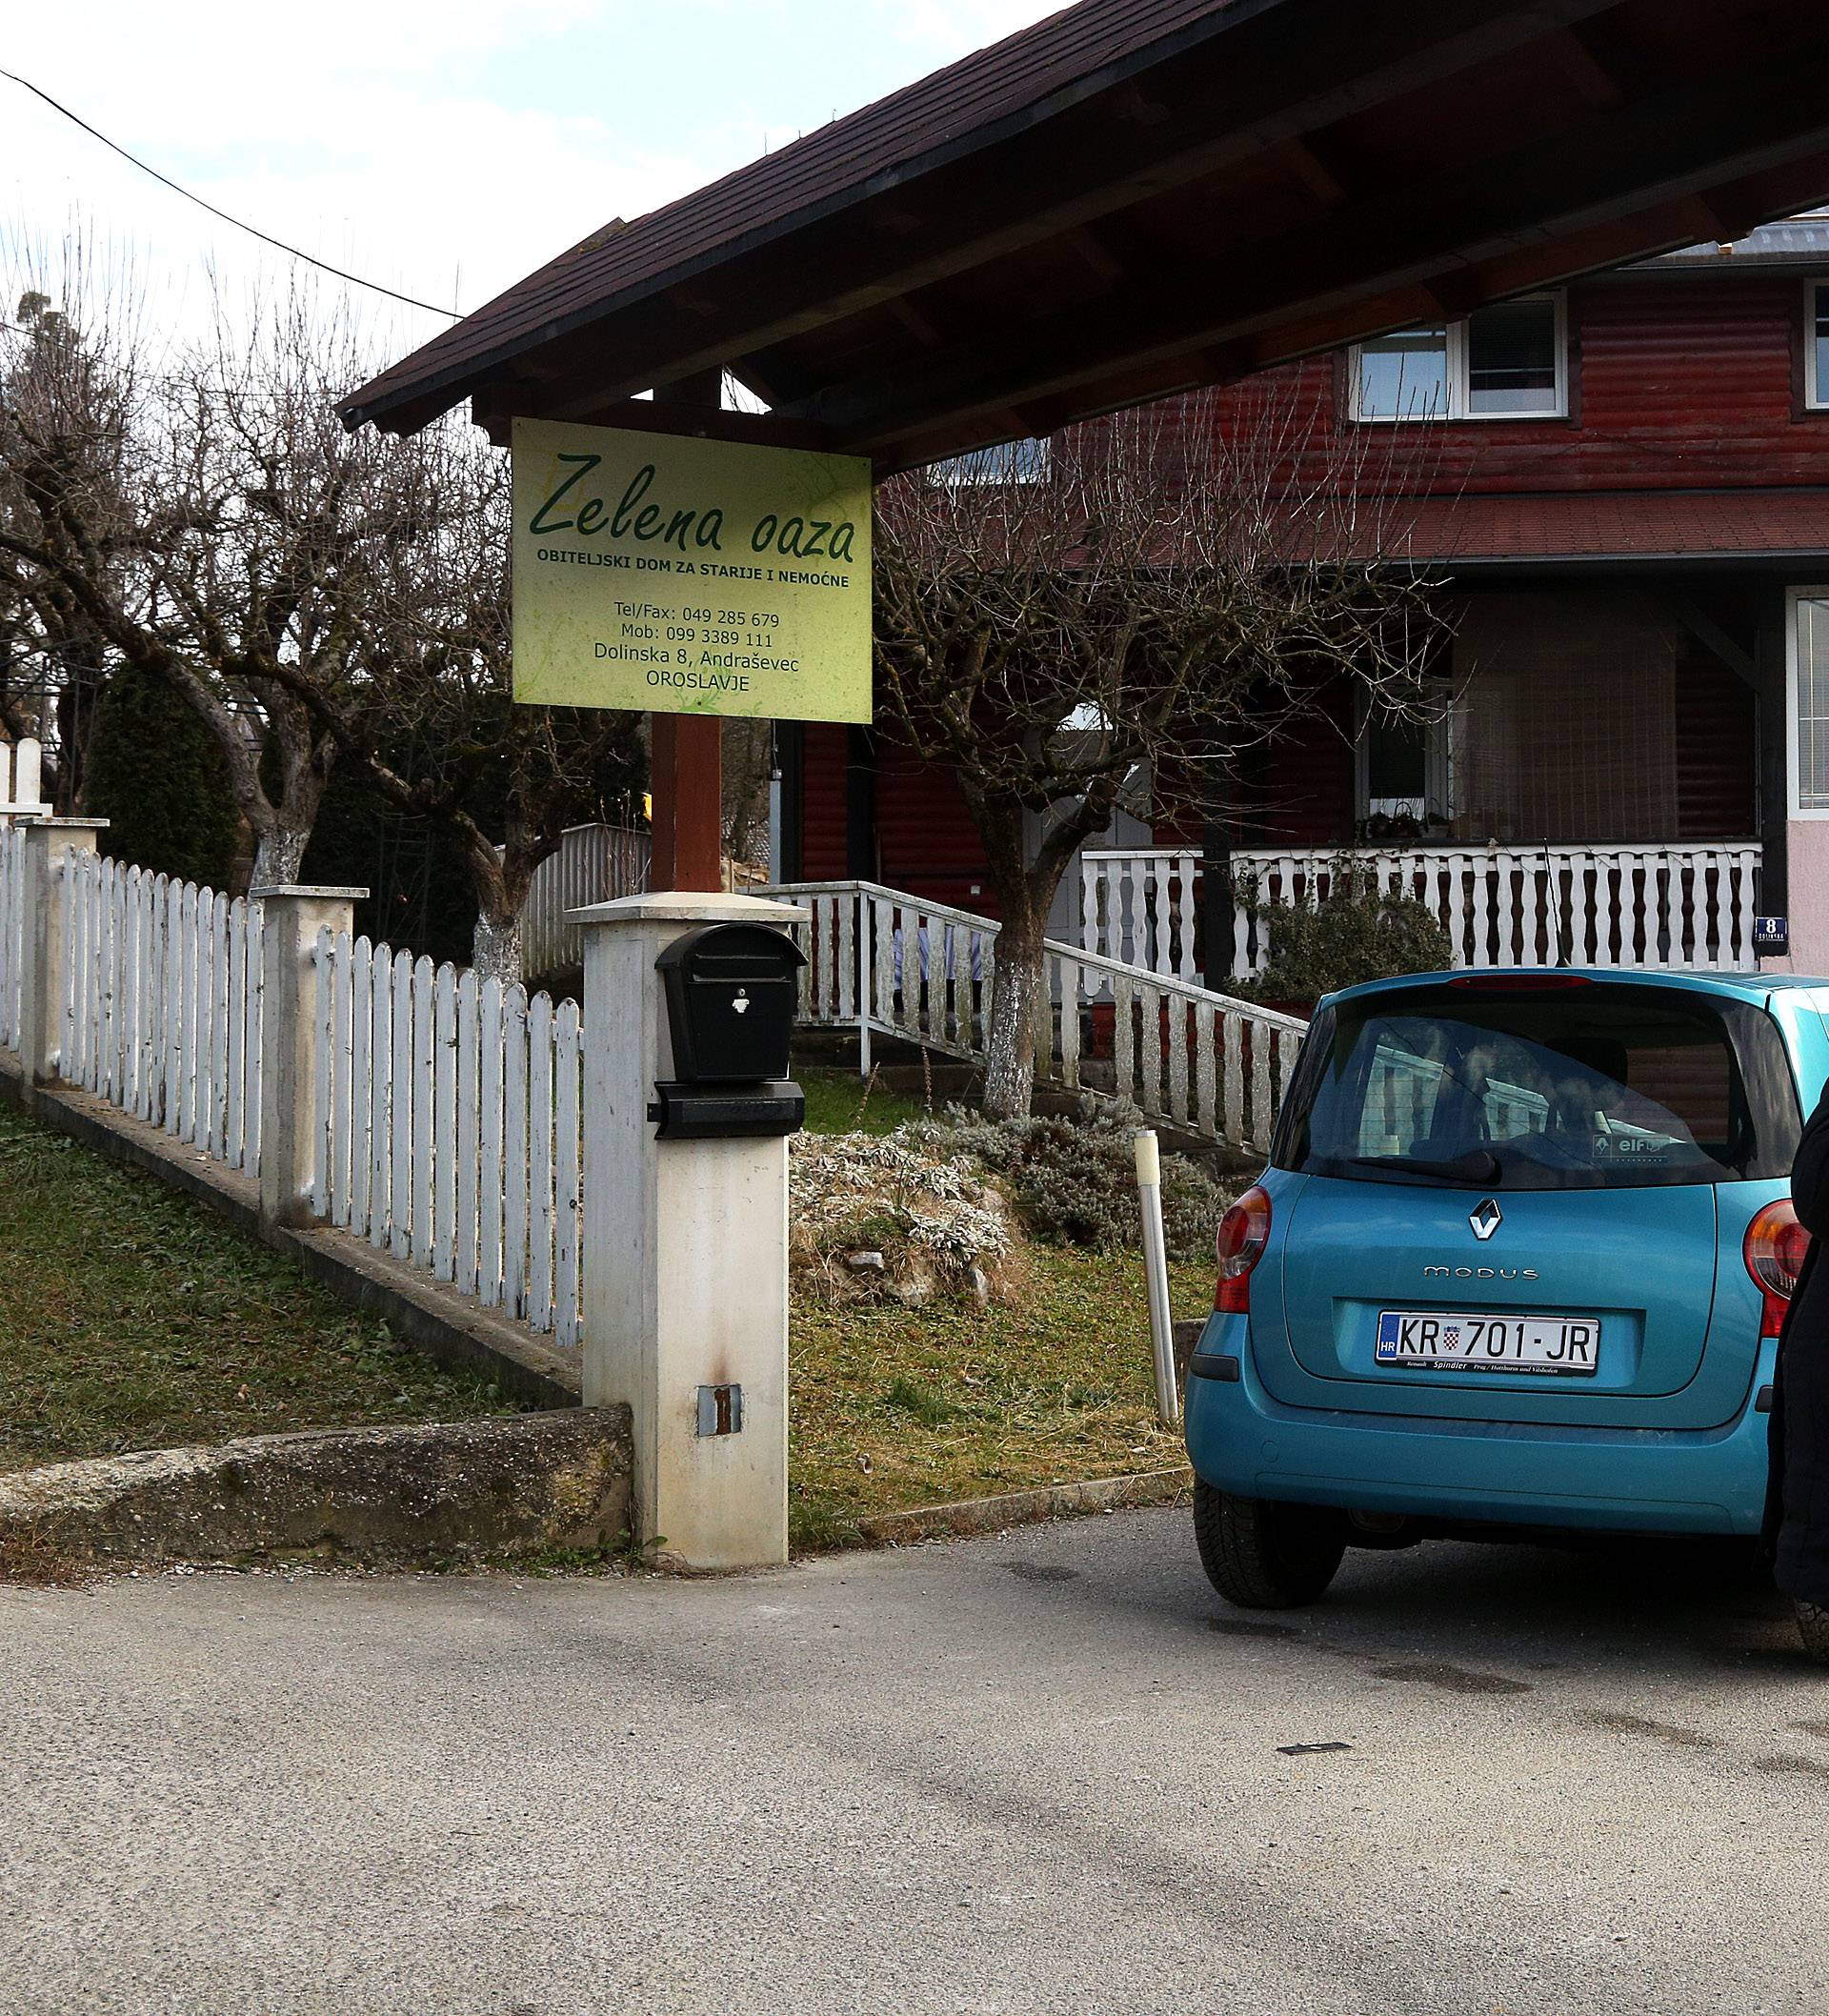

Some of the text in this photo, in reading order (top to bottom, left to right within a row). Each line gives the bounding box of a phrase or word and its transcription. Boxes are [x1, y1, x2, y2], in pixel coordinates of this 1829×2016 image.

[529, 453, 854, 564] Zelena oaza
[537, 549, 849, 588] OBITELJSKI DOM ZA STARIJE I NEMOĆNE
[613, 601, 779, 628] Tel/Fax: 049 285 679
[621, 623, 773, 648] Mob: 099 3389 111
[594, 642, 799, 672] Dolinska 8, Andraševec
[646, 670, 750, 692] OROSLAVJE
[1766, 918, 1777, 934] 8
[1619, 1139, 1645, 1152] elf
[1423, 1266, 1539, 1280] MODUS
[1380, 1341, 1396, 1352] HR
[1398, 1319, 1591, 1361] KR 701-JR
[1433, 1361, 1468, 1370] Spindler
